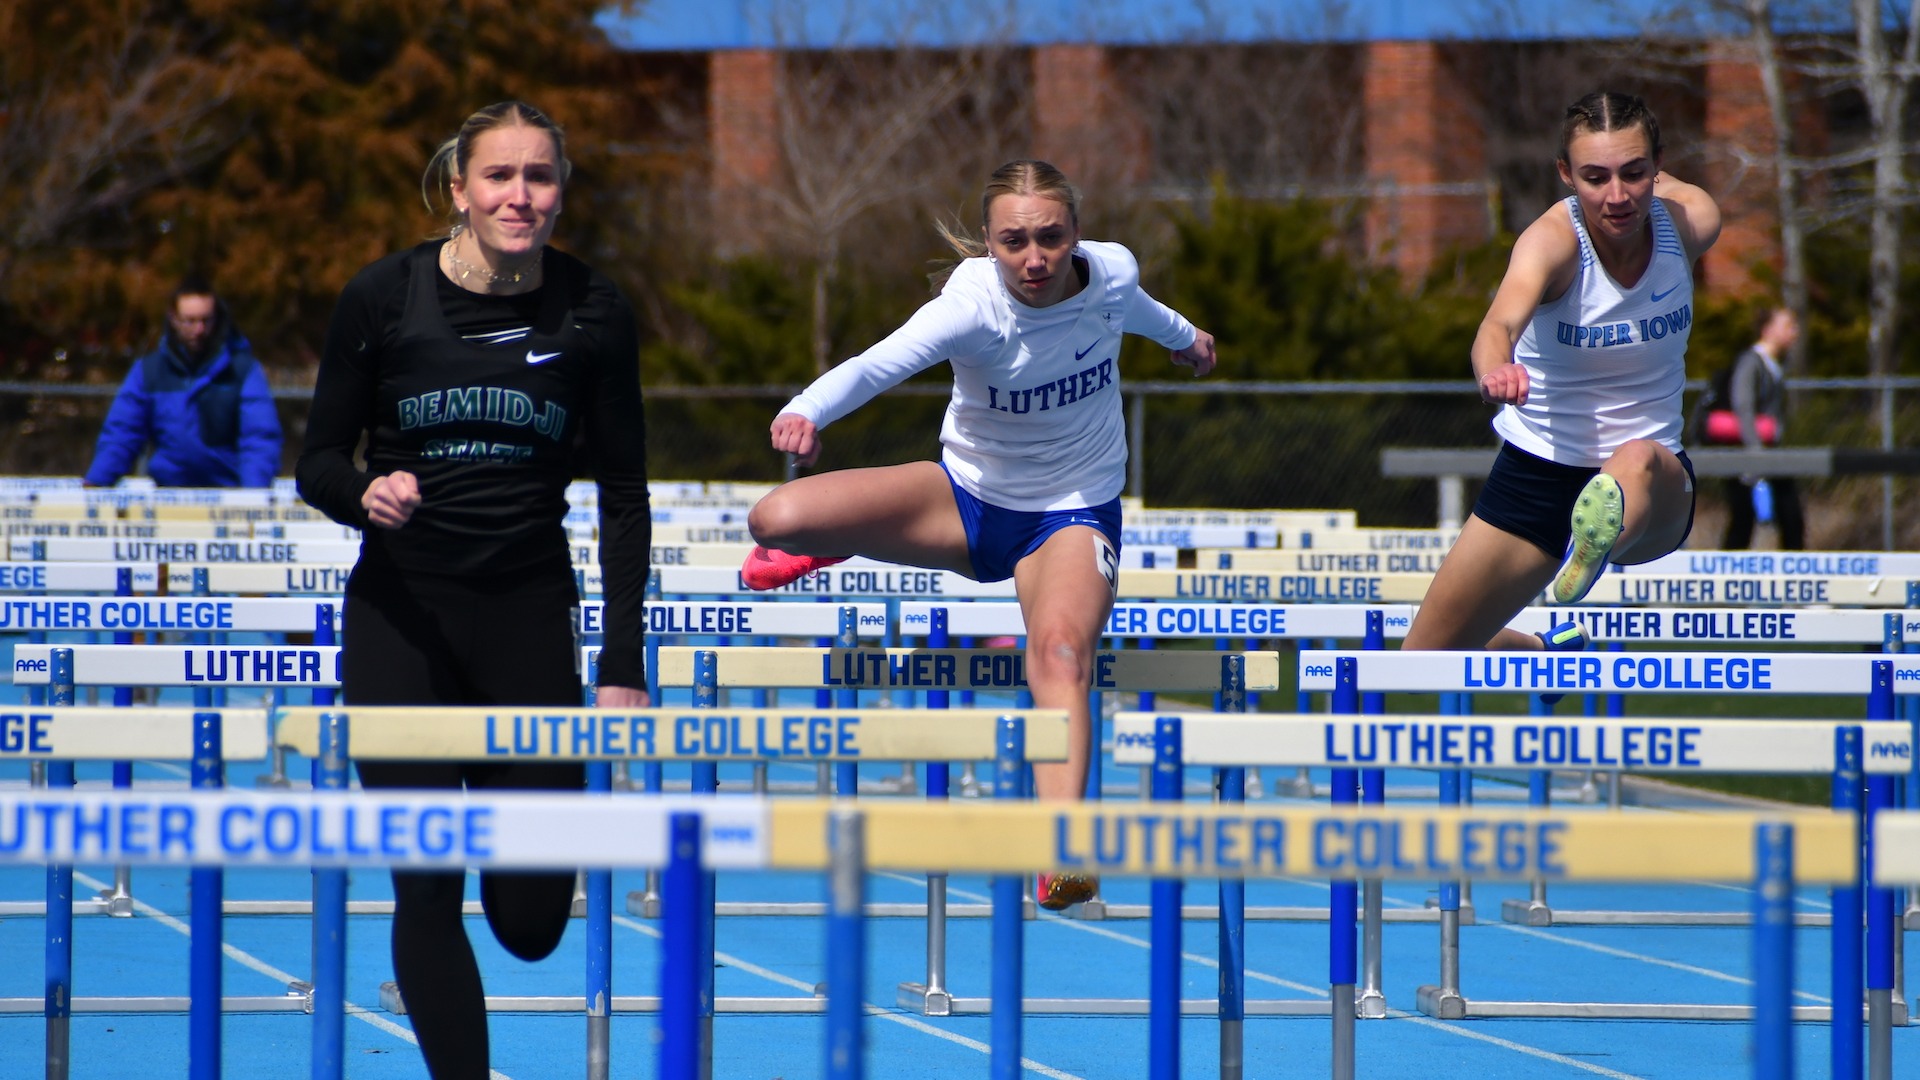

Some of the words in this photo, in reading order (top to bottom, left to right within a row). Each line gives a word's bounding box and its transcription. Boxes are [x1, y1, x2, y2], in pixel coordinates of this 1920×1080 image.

[1557, 321, 1632, 347] UPPER
[1639, 304, 1691, 341] IOWA
[988, 358, 1112, 414] LUTHER
[398, 386, 567, 441] BEMIDJI
[0, 524, 70, 537] UTHER
[686, 528, 751, 543] LUTHE
[1121, 530, 1193, 548] OLLEGE
[115, 542, 198, 561] LUTHER
[206, 543, 298, 562] COLLEGE
[1103, 543, 1116, 588] 5
[1298, 554, 1379, 572] LUTHER
[1388, 554, 1447, 573] COLL
[1690, 555, 1774, 574] LUTHER
[1781, 557, 1879, 576] COLLEGE
[287, 569, 350, 590] LUTH
[738, 571, 830, 592] LHER
[841, 571, 943, 593] COLLEGE
[1176, 574, 1271, 597] LUTHER
[1280, 576, 1383, 600] COLLEGE
[1620, 579, 1714, 602] LUTHER
[1724, 580, 1829, 601] COLLEGE
[0, 602, 91, 628] UTHER
[101, 602, 233, 629] COLLEGE
[1157, 608, 1286, 634] COLLEGE
[1672, 612, 1796, 639] COLLEGE
[184, 650, 321, 682] LUTHER
[822, 653, 956, 686] LUTHER
[970, 653, 1116, 688] COLE
[1464, 657, 1601, 688] LUTHER
[1612, 658, 1772, 690] COLLEGE
[485, 715, 656, 756] LUTHER
[674, 716, 861, 758] COLLEGE
[1325, 723, 1494, 764] LUTHER
[1513, 725, 1702, 766] COLLEGE
[0, 803, 196, 856] UTHER
[217, 803, 497, 858] COLLEGE
[1057, 813, 1286, 868] LUTHER
[1312, 816, 1570, 876] COLLEGE
